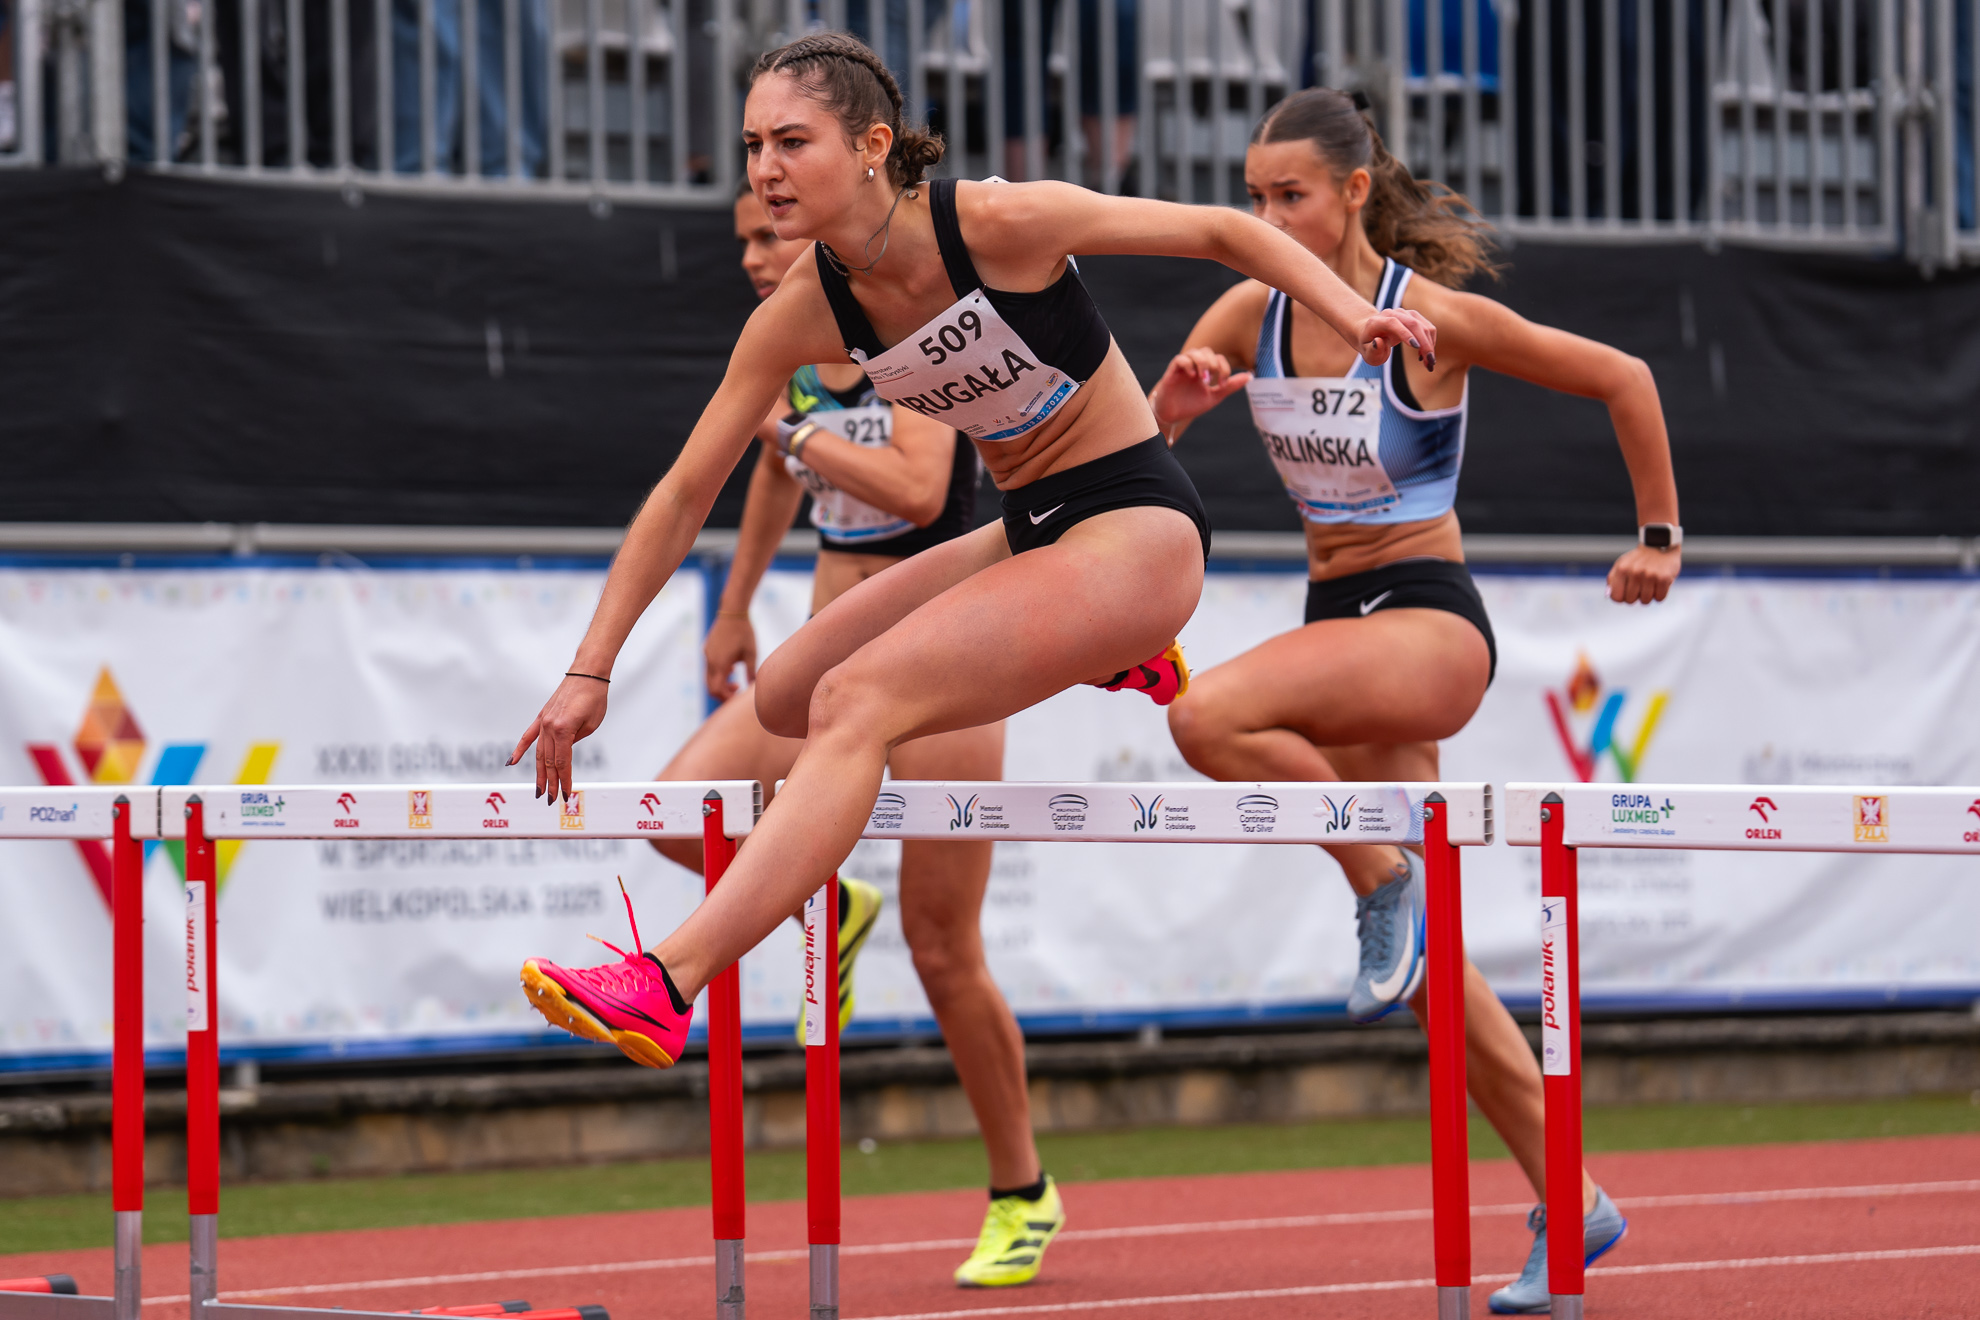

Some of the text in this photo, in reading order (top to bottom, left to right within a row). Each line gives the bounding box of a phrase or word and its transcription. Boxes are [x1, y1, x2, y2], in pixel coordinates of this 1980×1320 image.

[918, 310, 982, 365] 509
[1312, 388, 1366, 416] 872
[1015, 390, 1064, 433] 10-13.07.2025
[844, 416, 888, 443] 921
[241, 793, 269, 804] GRUPA
[1612, 794, 1652, 808] GRUPA
[241, 805, 275, 817] LUXMED
[871, 811, 904, 820] Continental
[1359, 806, 1384, 814] Memorial
[1051, 812, 1086, 821] Continental
[1240, 814, 1276, 823] Continental
[1612, 809, 1660, 823] LUXMED
[334, 819, 359, 828] ORLEN
[483, 819, 509, 829] ORLEN
[637, 820, 664, 830] ORLEN
[873, 820, 902, 829] Tour Silver
[1053, 821, 1084, 831] Tour Silver
[1242, 824, 1274, 833] Tour Silver
[1745, 828, 1782, 839] ORLEN
[1854, 826, 1887, 840] PZLA
[186, 916, 200, 993] polanik
[805, 921, 819, 1005] polanik
[1542, 934, 1561, 1030] polanik
